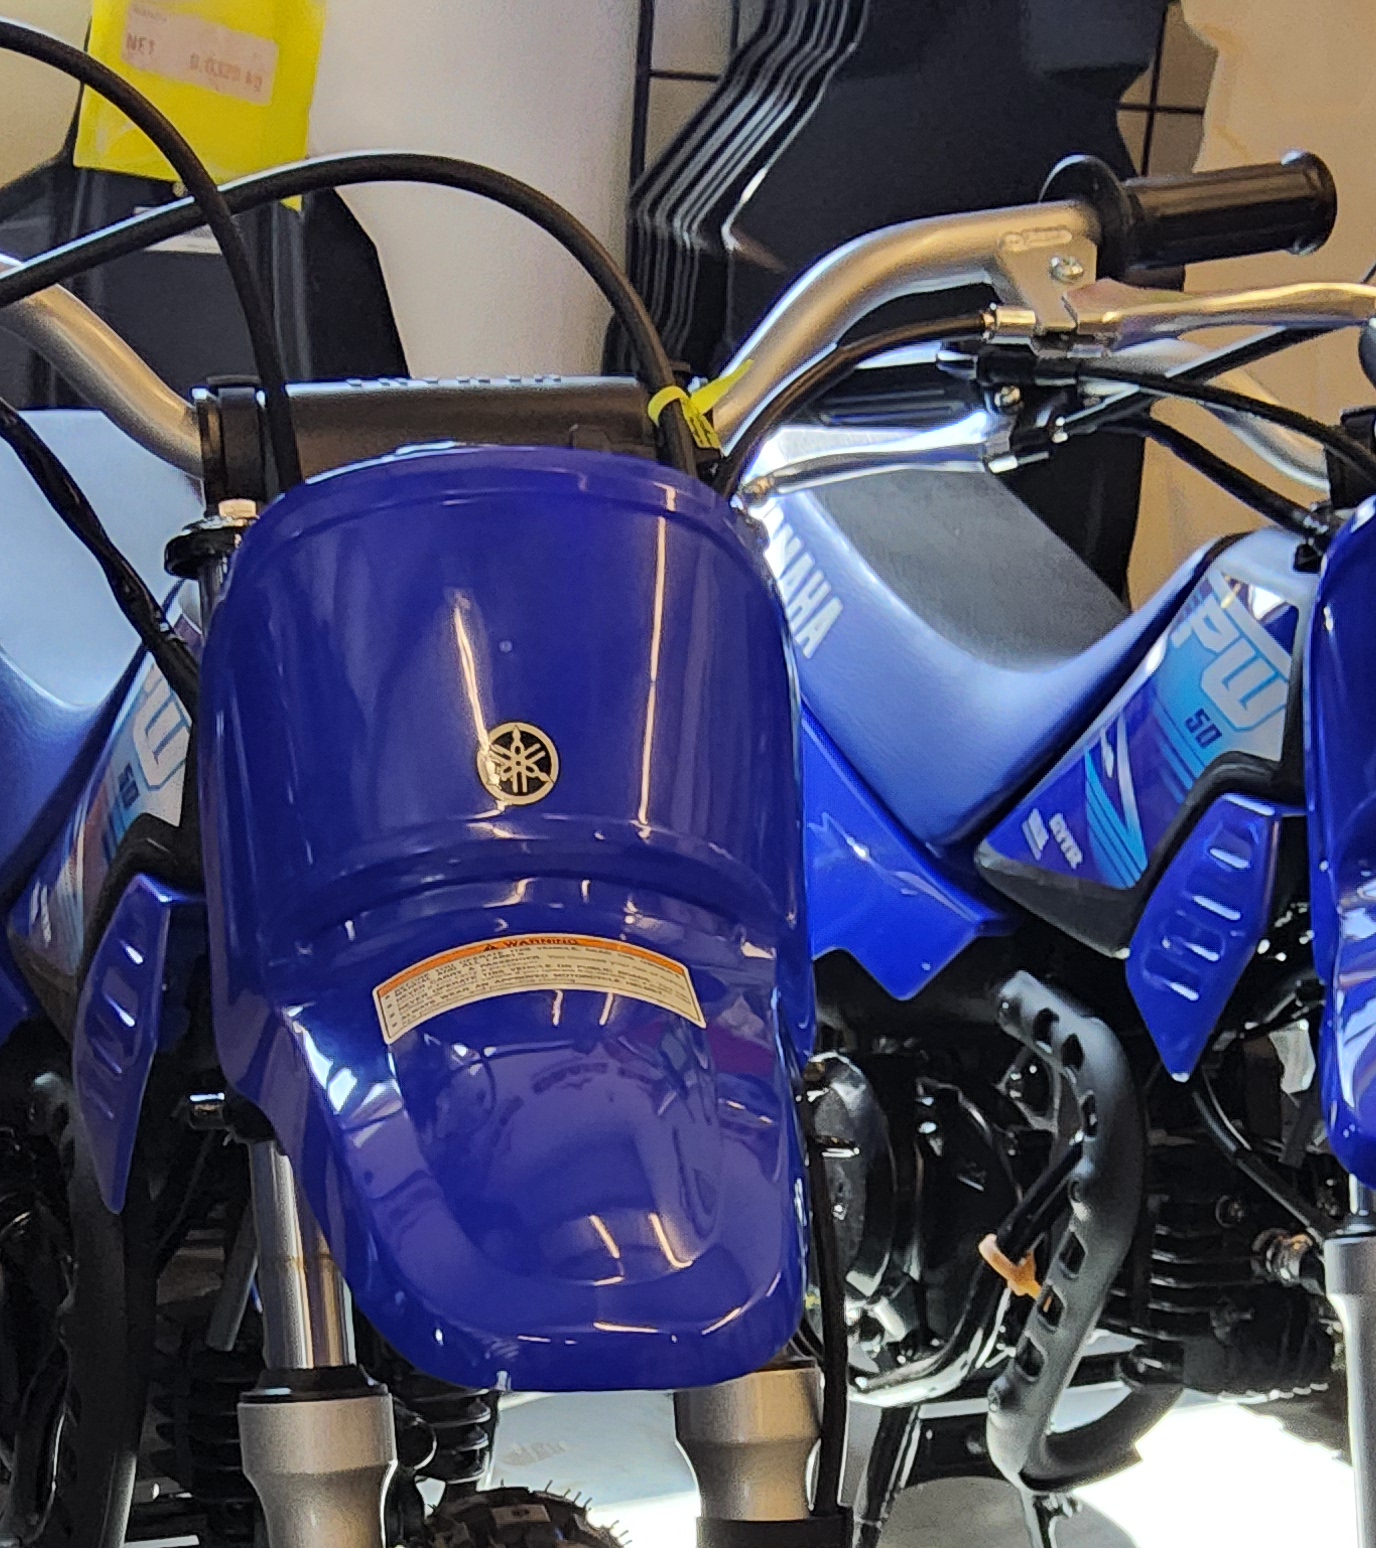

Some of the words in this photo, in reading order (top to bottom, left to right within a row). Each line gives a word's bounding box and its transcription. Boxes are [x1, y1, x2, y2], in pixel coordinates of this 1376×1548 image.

[761, 500, 844, 659] AMAHA
[1171, 594, 1288, 731] PW
[1185, 708, 1222, 748] 50
[502, 937, 579, 949] WARNING
